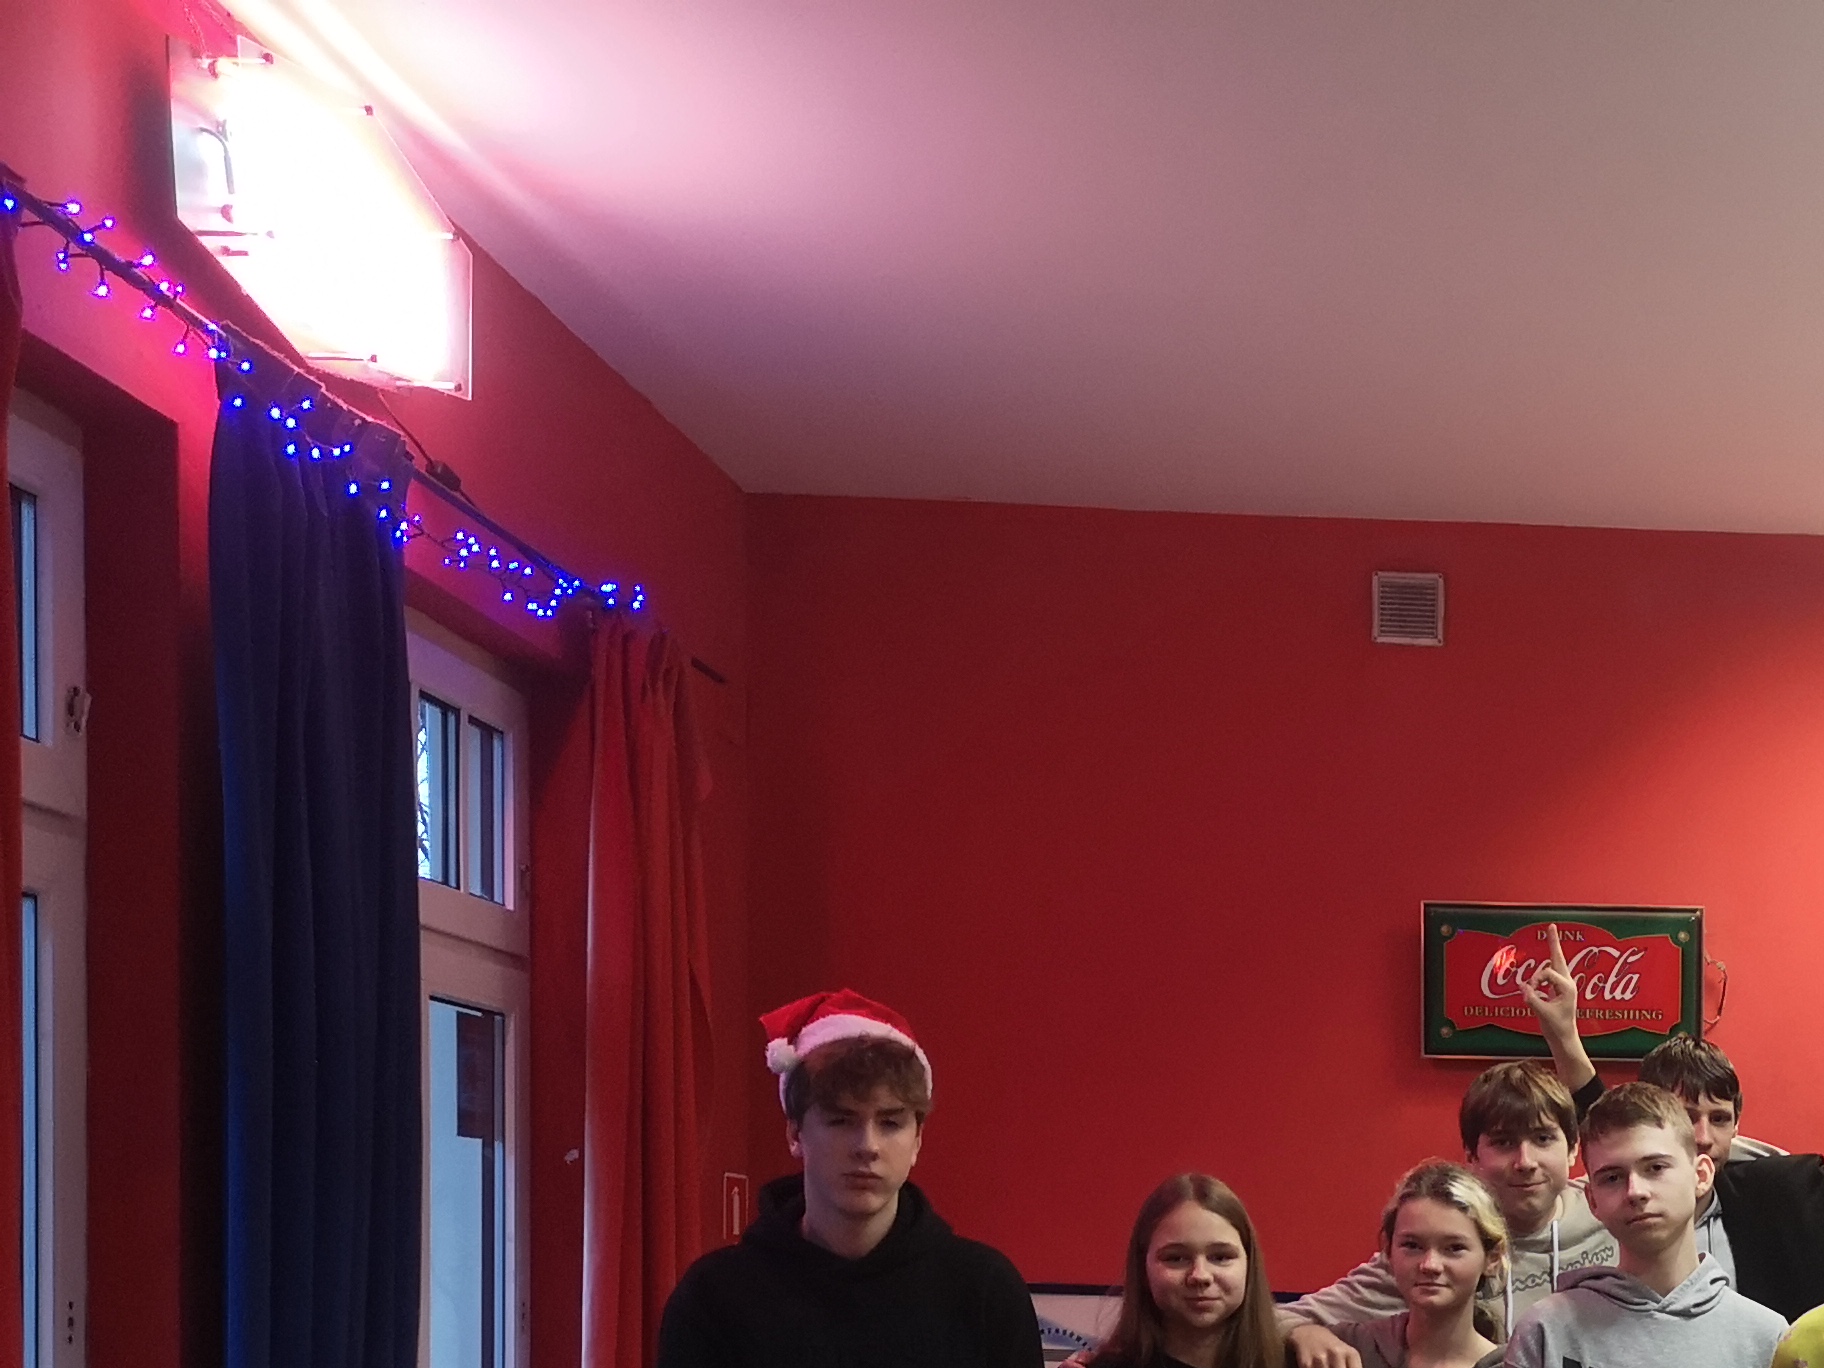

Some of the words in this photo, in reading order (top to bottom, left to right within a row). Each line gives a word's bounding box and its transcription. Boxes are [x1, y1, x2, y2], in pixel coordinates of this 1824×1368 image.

[1536, 929, 1585, 941] DINK
[1463, 1005, 1536, 1017] DELICIOU
[1576, 1008, 1664, 1020] EFRESHING
